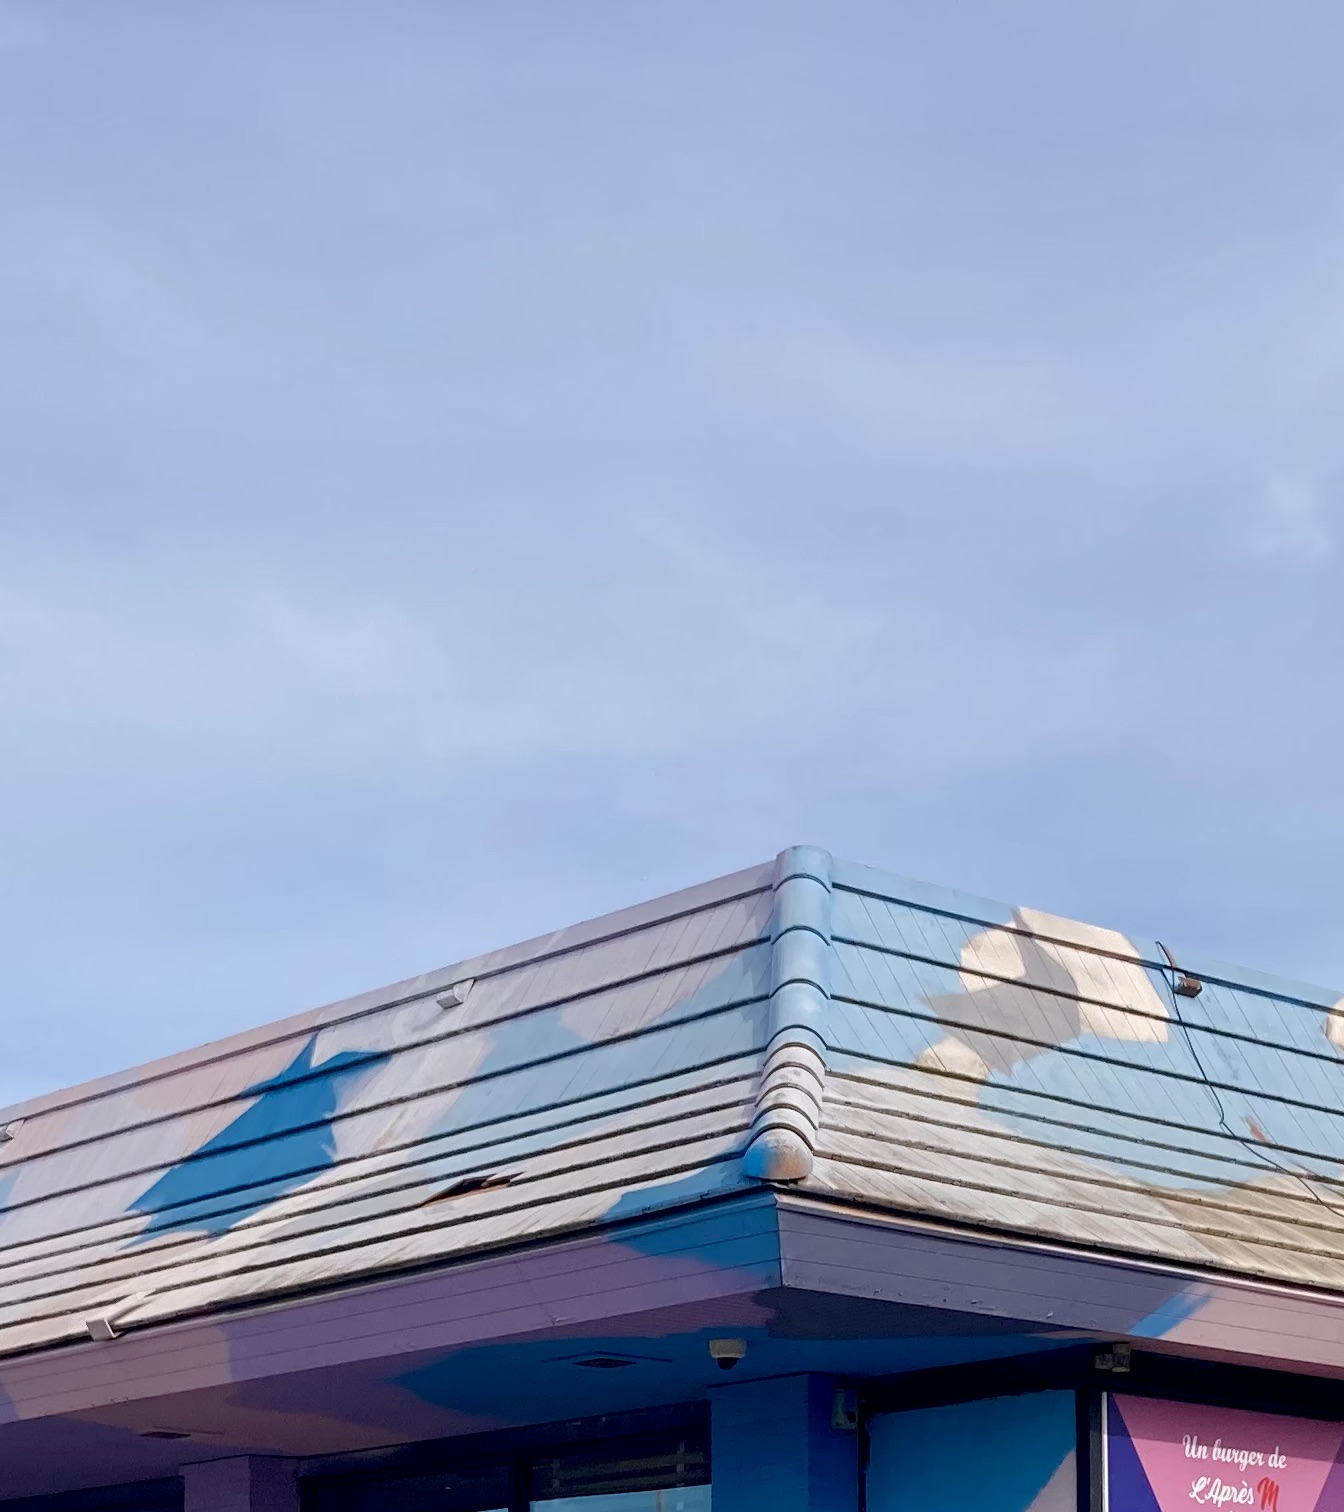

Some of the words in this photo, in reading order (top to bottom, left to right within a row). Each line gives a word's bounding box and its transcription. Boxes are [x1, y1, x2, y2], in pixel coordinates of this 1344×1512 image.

[1182, 1434, 1208, 1459] Un
[1212, 1438, 1265, 1472] burger
[1268, 1445, 1287, 1469] de
[1189, 1476, 1255, 1508] L'Après
